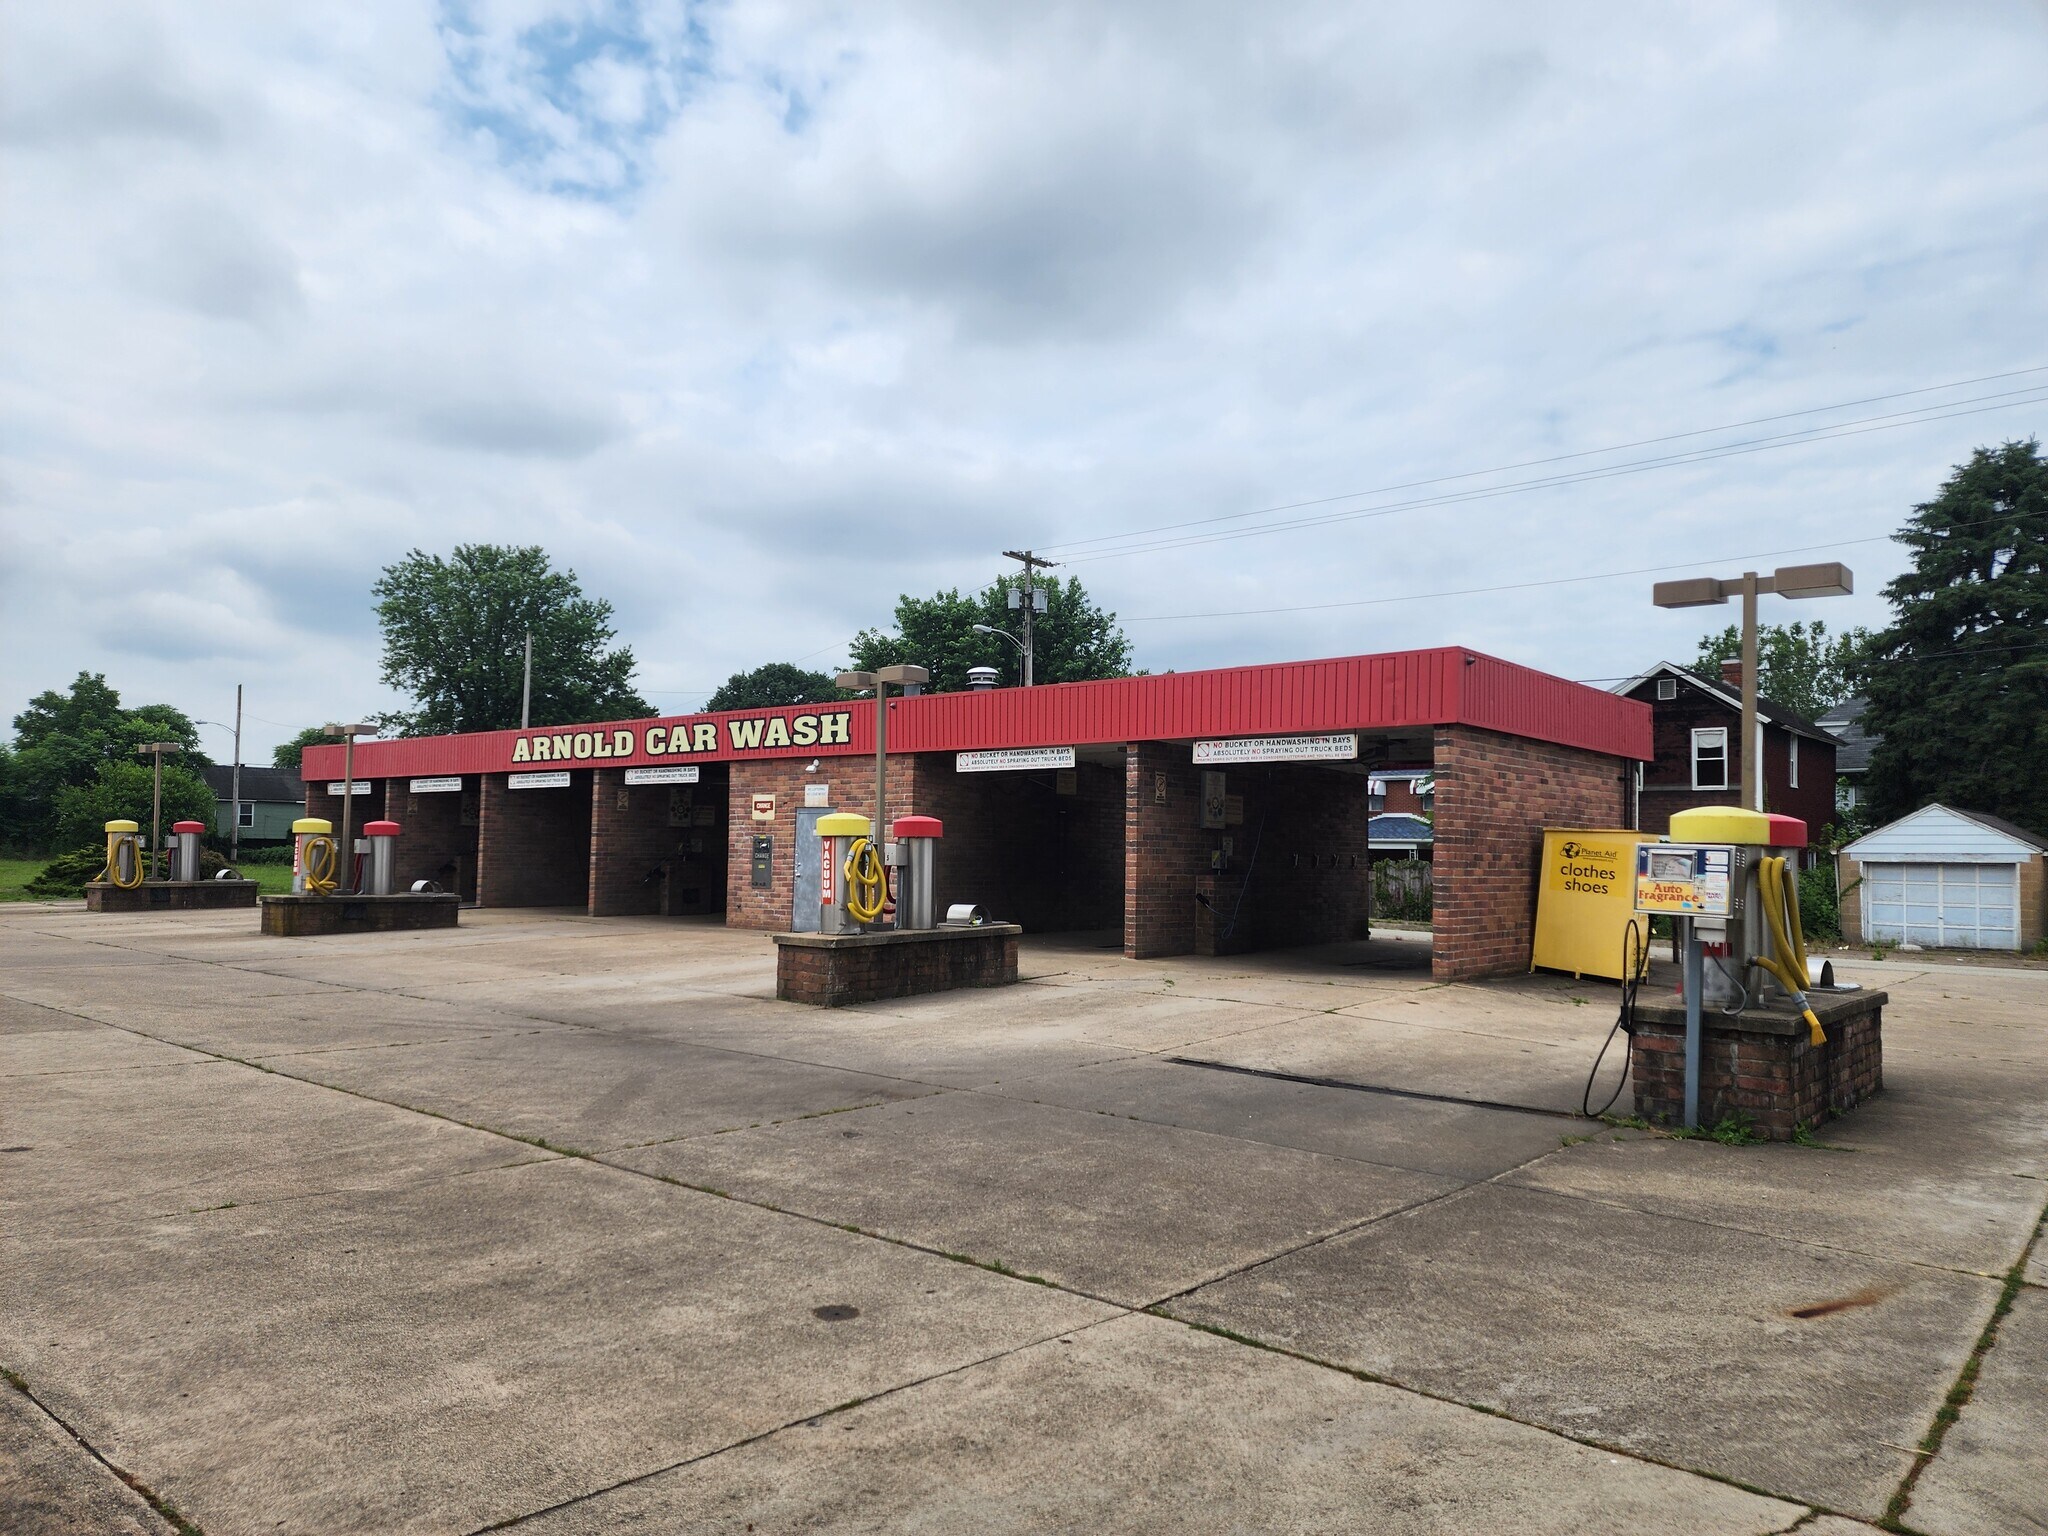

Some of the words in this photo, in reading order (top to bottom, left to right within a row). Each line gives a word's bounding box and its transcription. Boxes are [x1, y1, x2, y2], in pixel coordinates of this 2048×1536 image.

[512, 730, 634, 762] ARNOLD
[645, 724, 717, 755] CAR
[728, 713, 850, 749] WASH
[1266, 738, 1320, 746] HANDWASHING
[1581, 848, 1602, 856] Planet
[822, 840, 831, 898] VACUUM
[1560, 863, 1616, 880] clothes
[1565, 878, 1608, 894] shoes
[1654, 884, 1683, 894] Auto
[1638, 890, 1699, 902] Fragrance
